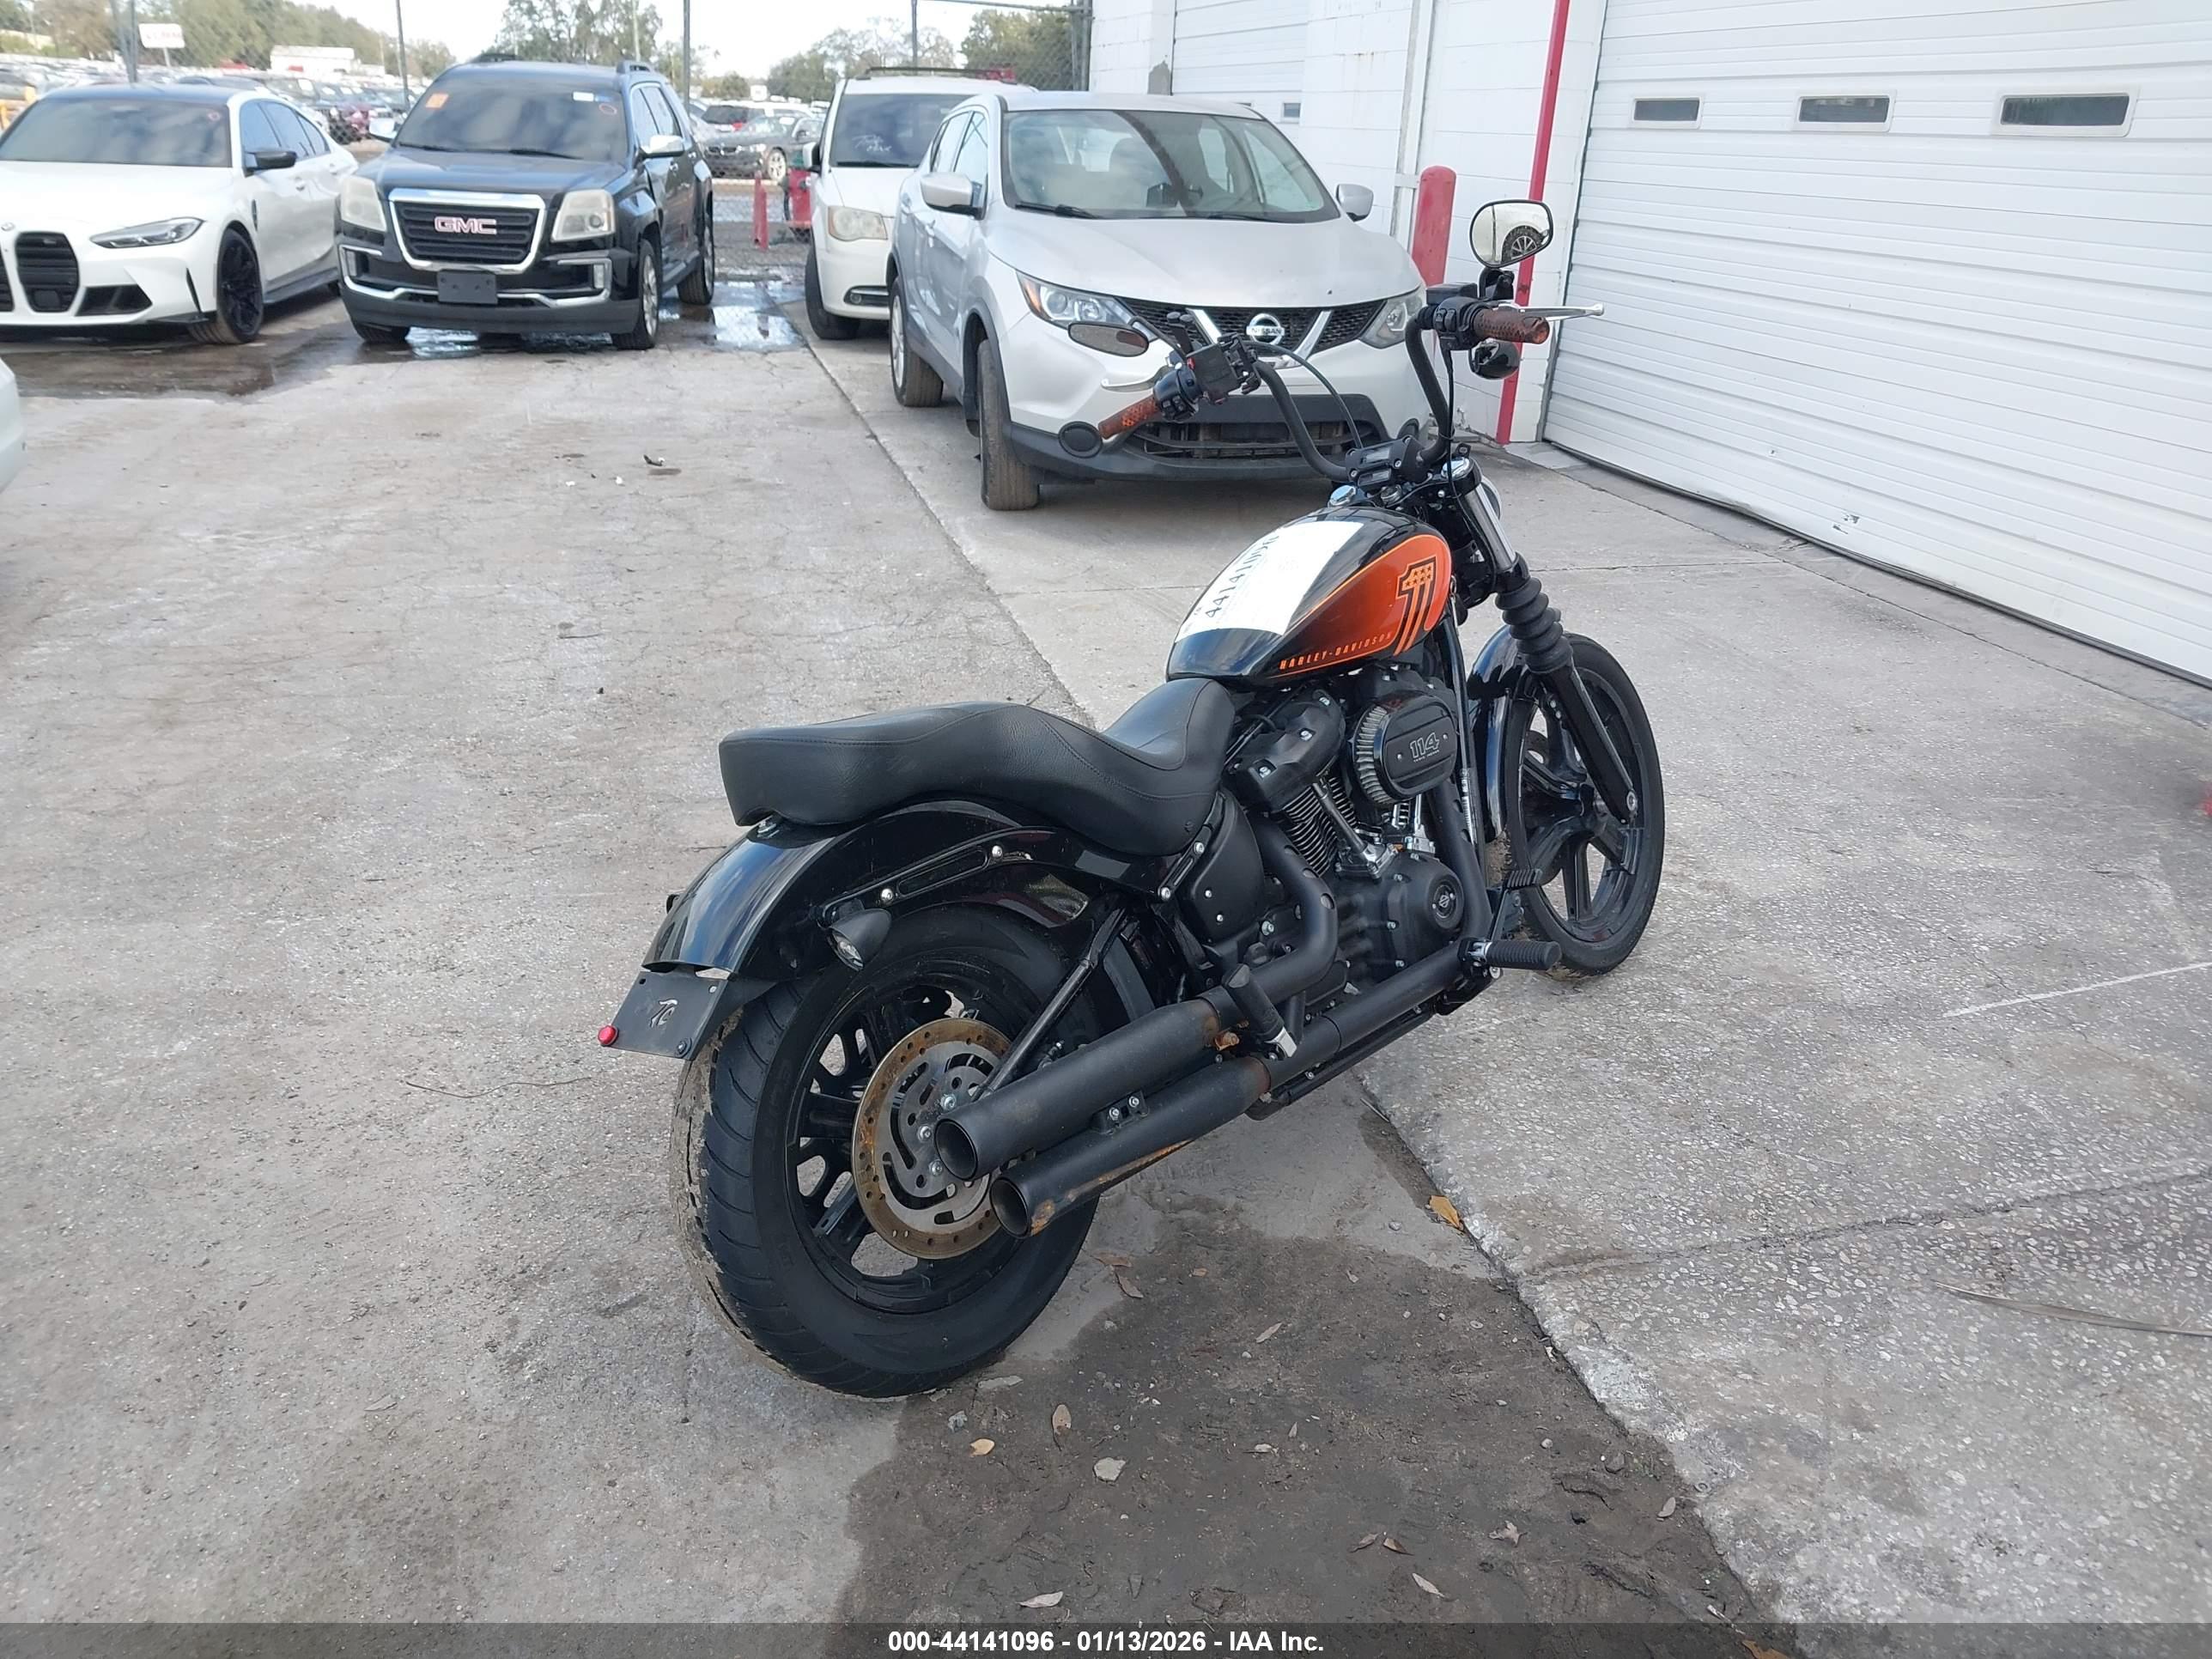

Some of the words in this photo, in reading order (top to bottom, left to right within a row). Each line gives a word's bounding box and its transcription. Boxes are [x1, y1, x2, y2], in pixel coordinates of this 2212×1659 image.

[434, 216, 497, 234] GMC
[1279, 632, 1391, 670] HARLEY-DAVIDSON
[1409, 732, 1440, 758] 114
